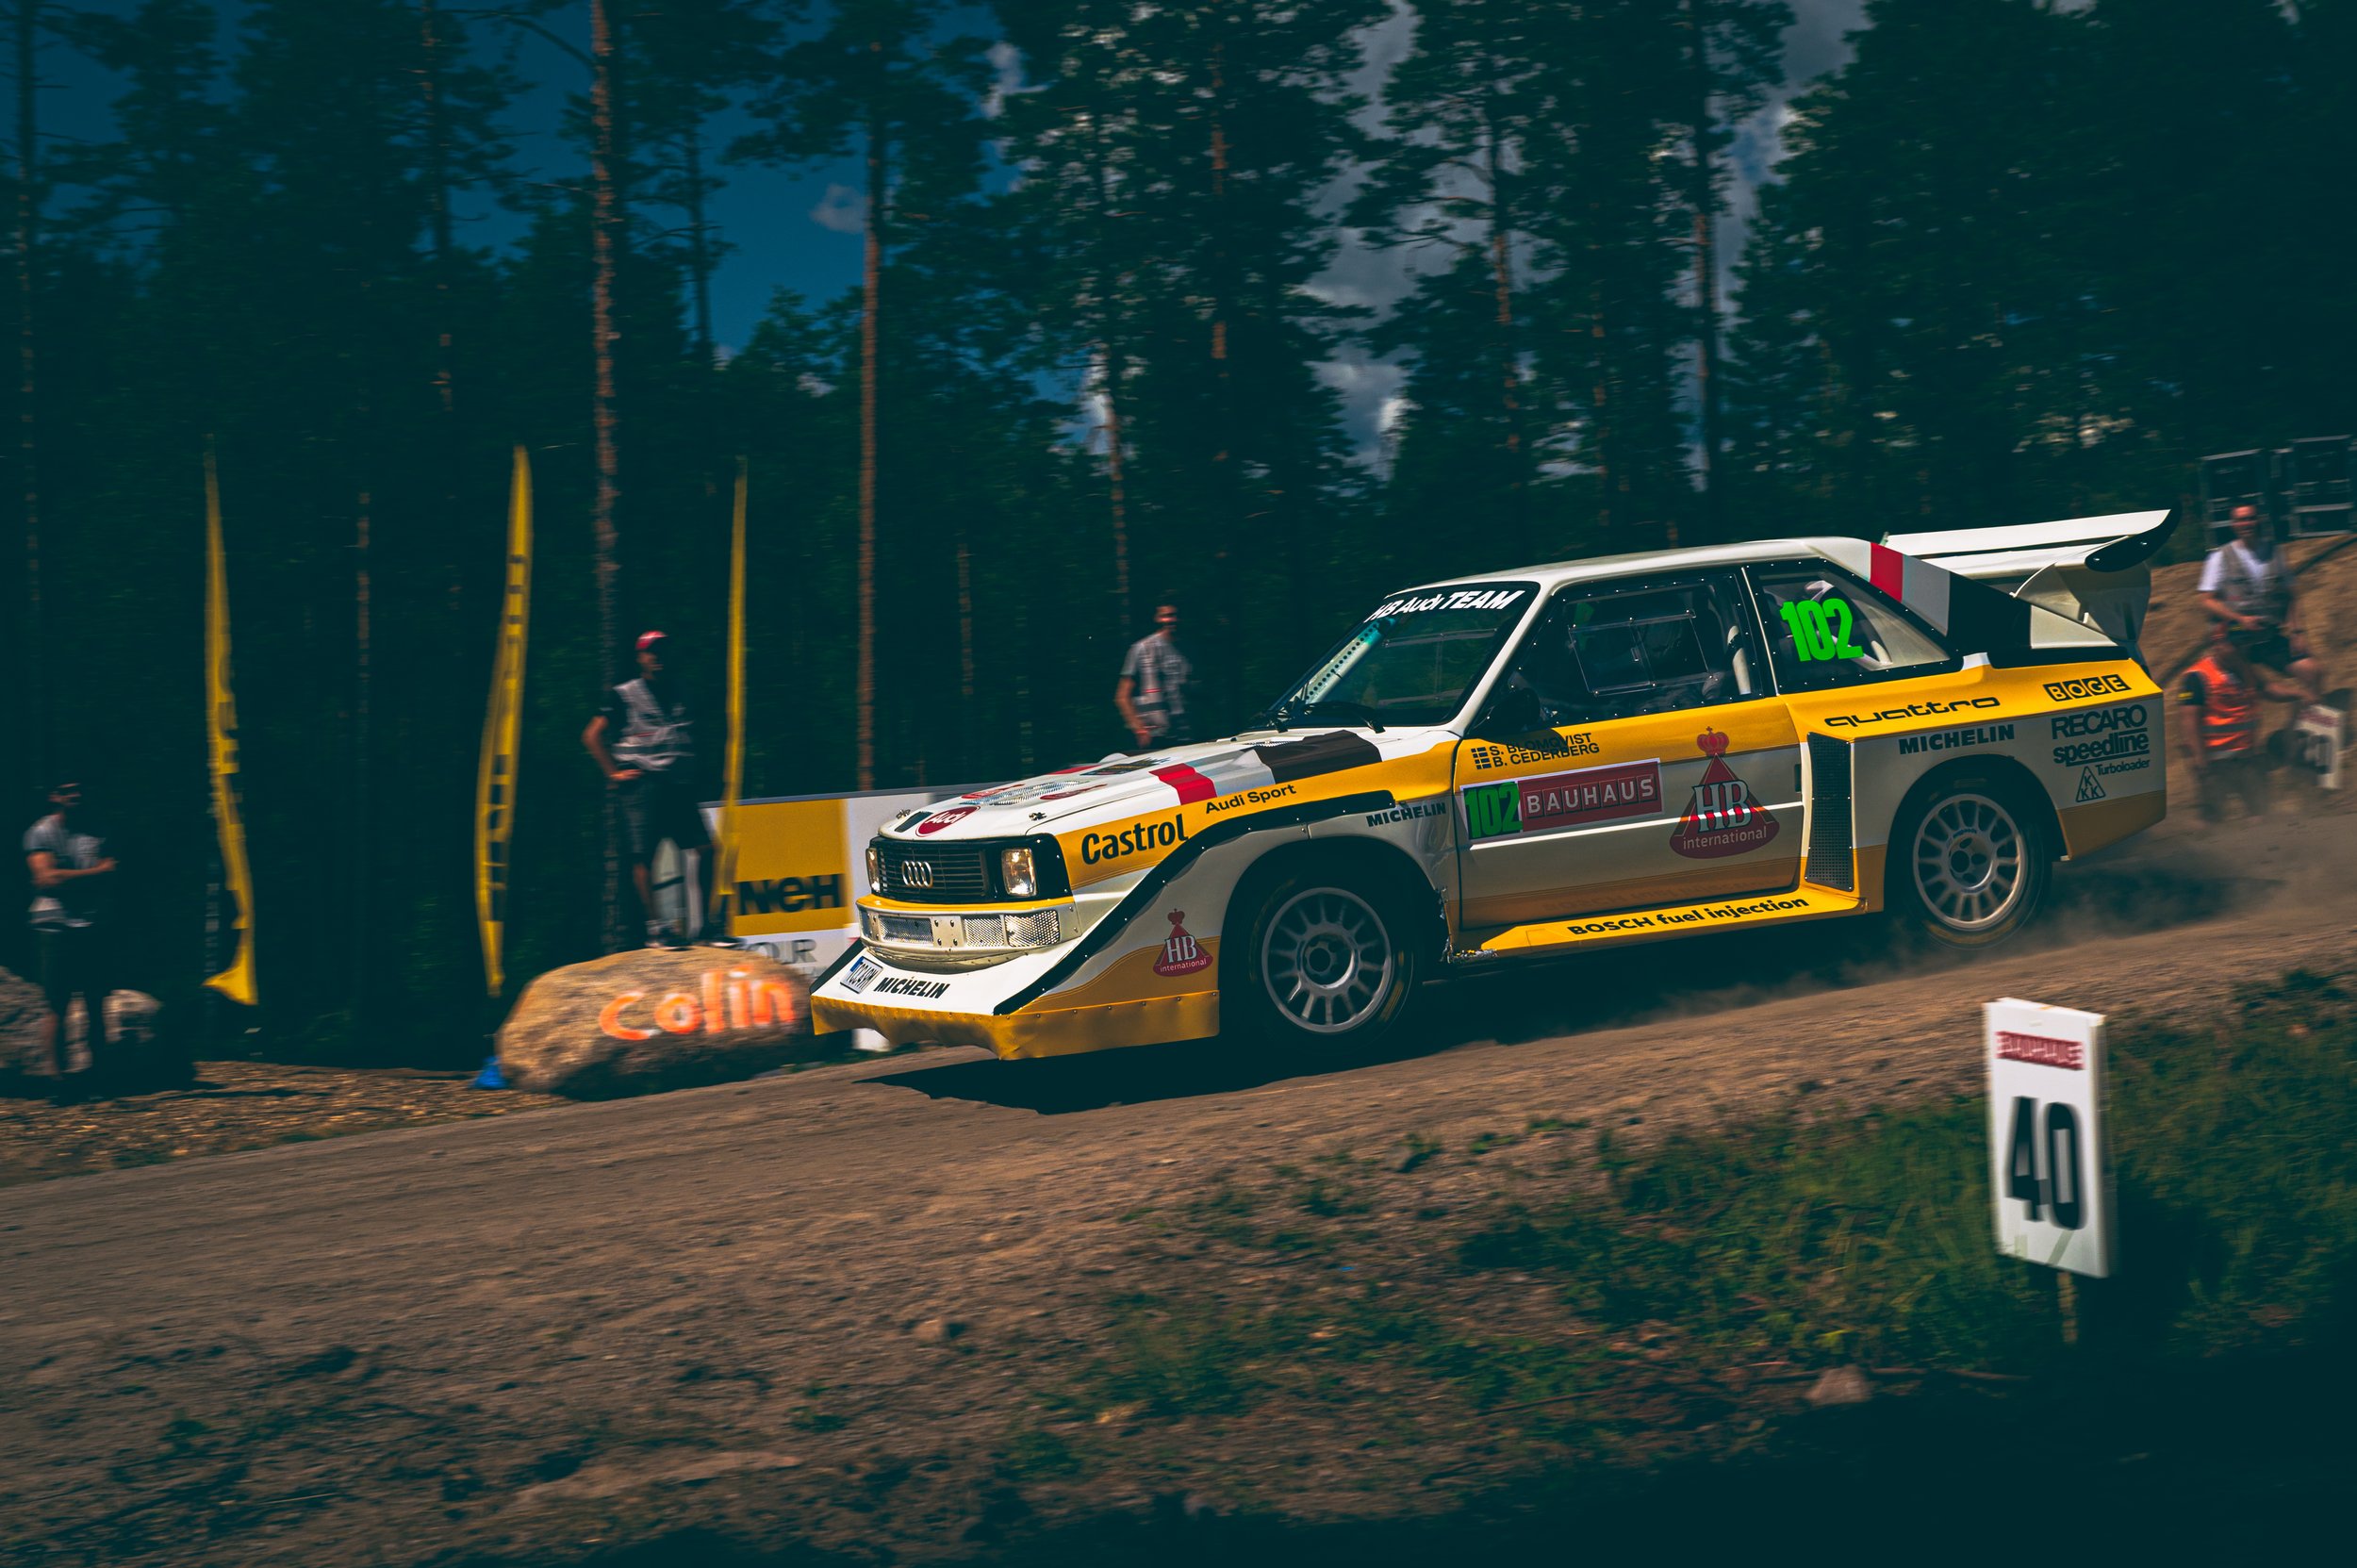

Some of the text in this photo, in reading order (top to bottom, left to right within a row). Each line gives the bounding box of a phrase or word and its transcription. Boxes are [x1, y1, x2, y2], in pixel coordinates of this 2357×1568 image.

[1439, 590, 1525, 610] TEAM
[1779, 598, 1864, 662] 102
[2046, 675, 2129, 701] BOGE
[1824, 697, 2001, 727] quattro
[2052, 704, 2147, 739] RECARO
[1489, 746, 1505, 756] S.
[1899, 724, 2015, 754] MICHELIN
[2053, 730, 2150, 766] speedline
[1492, 742, 1600, 767] B. CEDERBERG
[2095, 759, 2151, 776] Turboloader
[1206, 784, 1296, 814] Audi Sport
[1465, 778, 1656, 838] 102 BAUHAUS
[1692, 780, 1753, 833] HB
[1366, 803, 1446, 827] MICHELIN
[1081, 814, 1189, 865] Castrol
[1683, 826, 1767, 850] international
[1567, 898, 1809, 935] BOSCH fuel injection
[1165, 934, 1197, 963] HB
[1160, 958, 1207, 972] international
[873, 977, 950, 999] MICHELIN
[2006, 1096, 2087, 1230] 40
